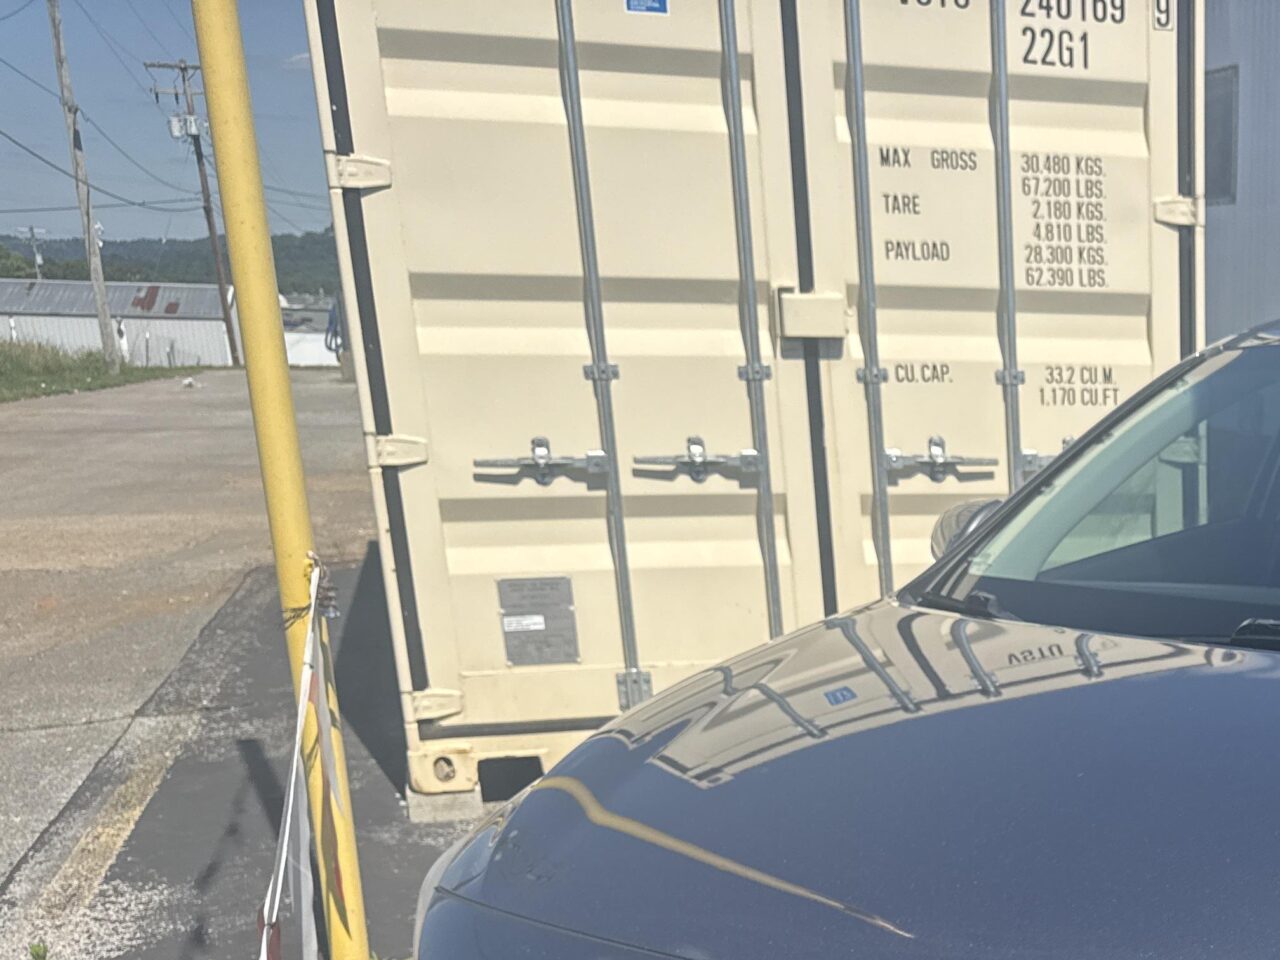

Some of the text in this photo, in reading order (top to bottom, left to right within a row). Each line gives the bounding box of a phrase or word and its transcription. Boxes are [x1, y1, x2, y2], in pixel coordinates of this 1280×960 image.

[1156, 0, 1171, 28] 9
[1022, 26, 1088, 69] 22G1
[879, 147, 1106, 177] MAX GROSS 30.480 KGS.
[1021, 177, 1107, 200] 67.200 LBS.
[882, 194, 1107, 222] TARE 2.180 KGS.
[1033, 222, 1108, 244] 4.810 LBS.
[885, 240, 1108, 266] PAYLOAD 28.300 KGS.
[1025, 267, 1109, 288] 62.390 LBS.
[1045, 366, 1076, 385] 33.2
[1039, 388, 1076, 406] 1.170
